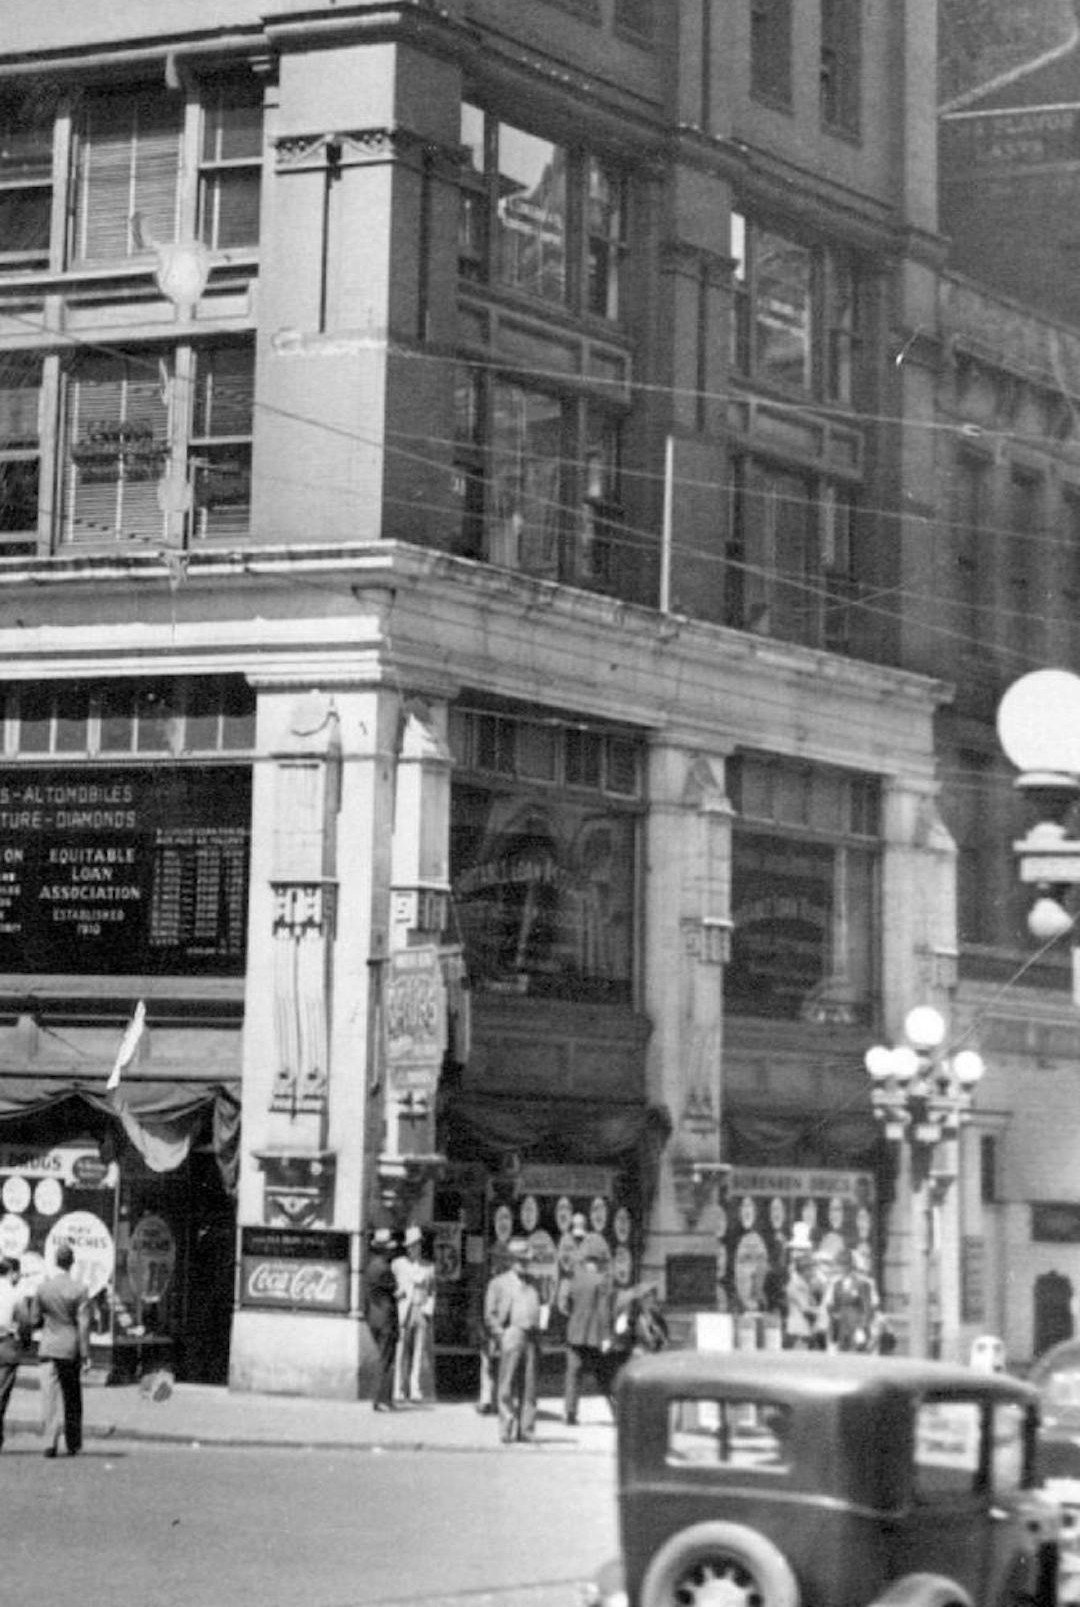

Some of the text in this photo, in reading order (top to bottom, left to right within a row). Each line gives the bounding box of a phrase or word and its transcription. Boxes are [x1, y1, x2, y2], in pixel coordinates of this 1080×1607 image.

[55, 810, 137, 829] DIAMONDS
[4, 848, 24, 863] ON
[48, 848, 136, 864] EQUITABLE
[71, 867, 113, 881] LOAN
[38, 885, 142, 900] ASSOCIATION
